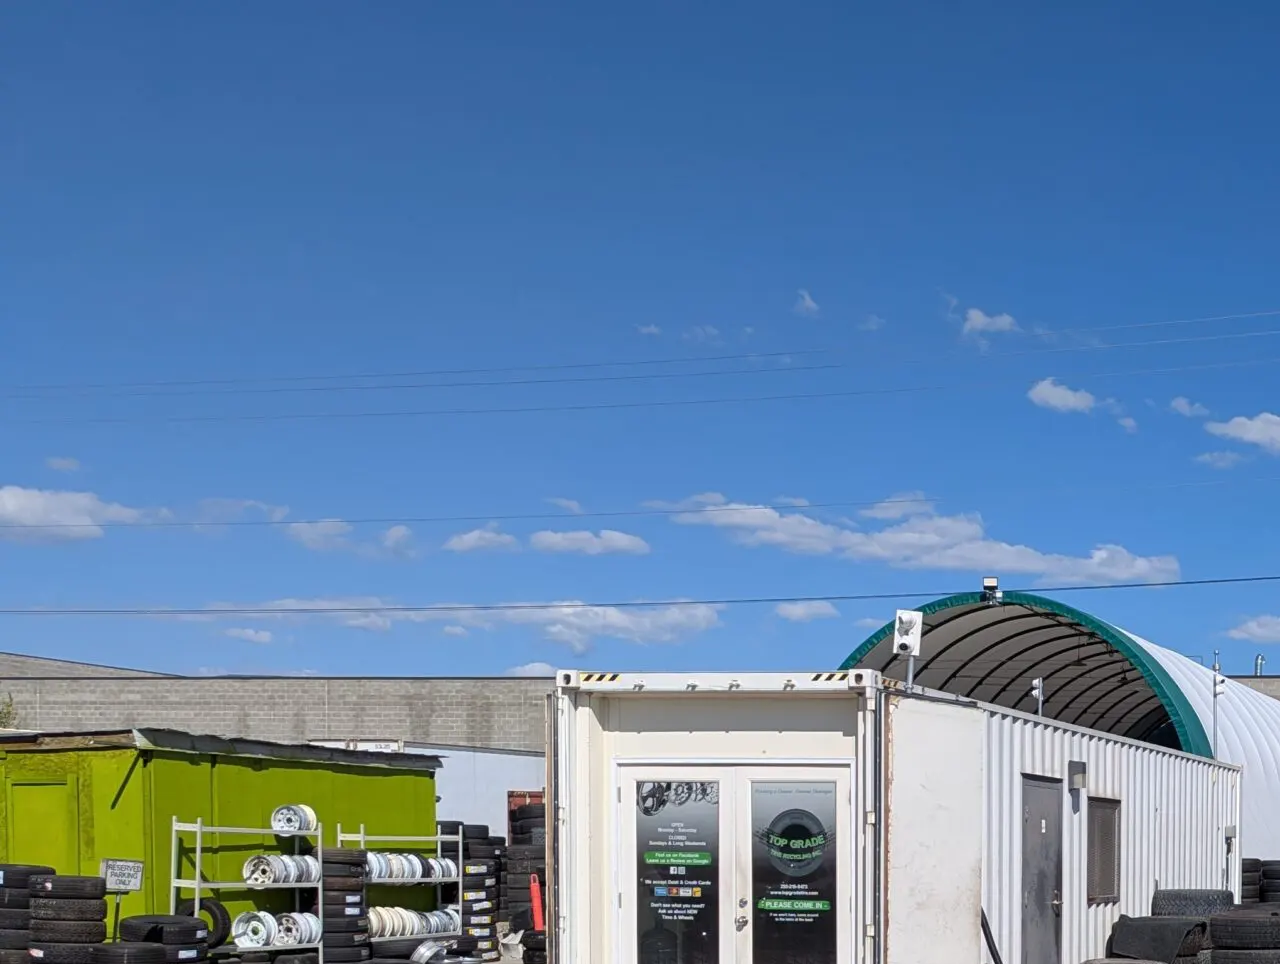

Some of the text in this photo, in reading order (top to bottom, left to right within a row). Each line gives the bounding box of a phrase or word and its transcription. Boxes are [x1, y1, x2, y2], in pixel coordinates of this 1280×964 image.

[769, 834, 825, 849] TOP GRADE
[106, 863, 141, 872] RESERVED
[110, 871, 138, 879] PARKING
